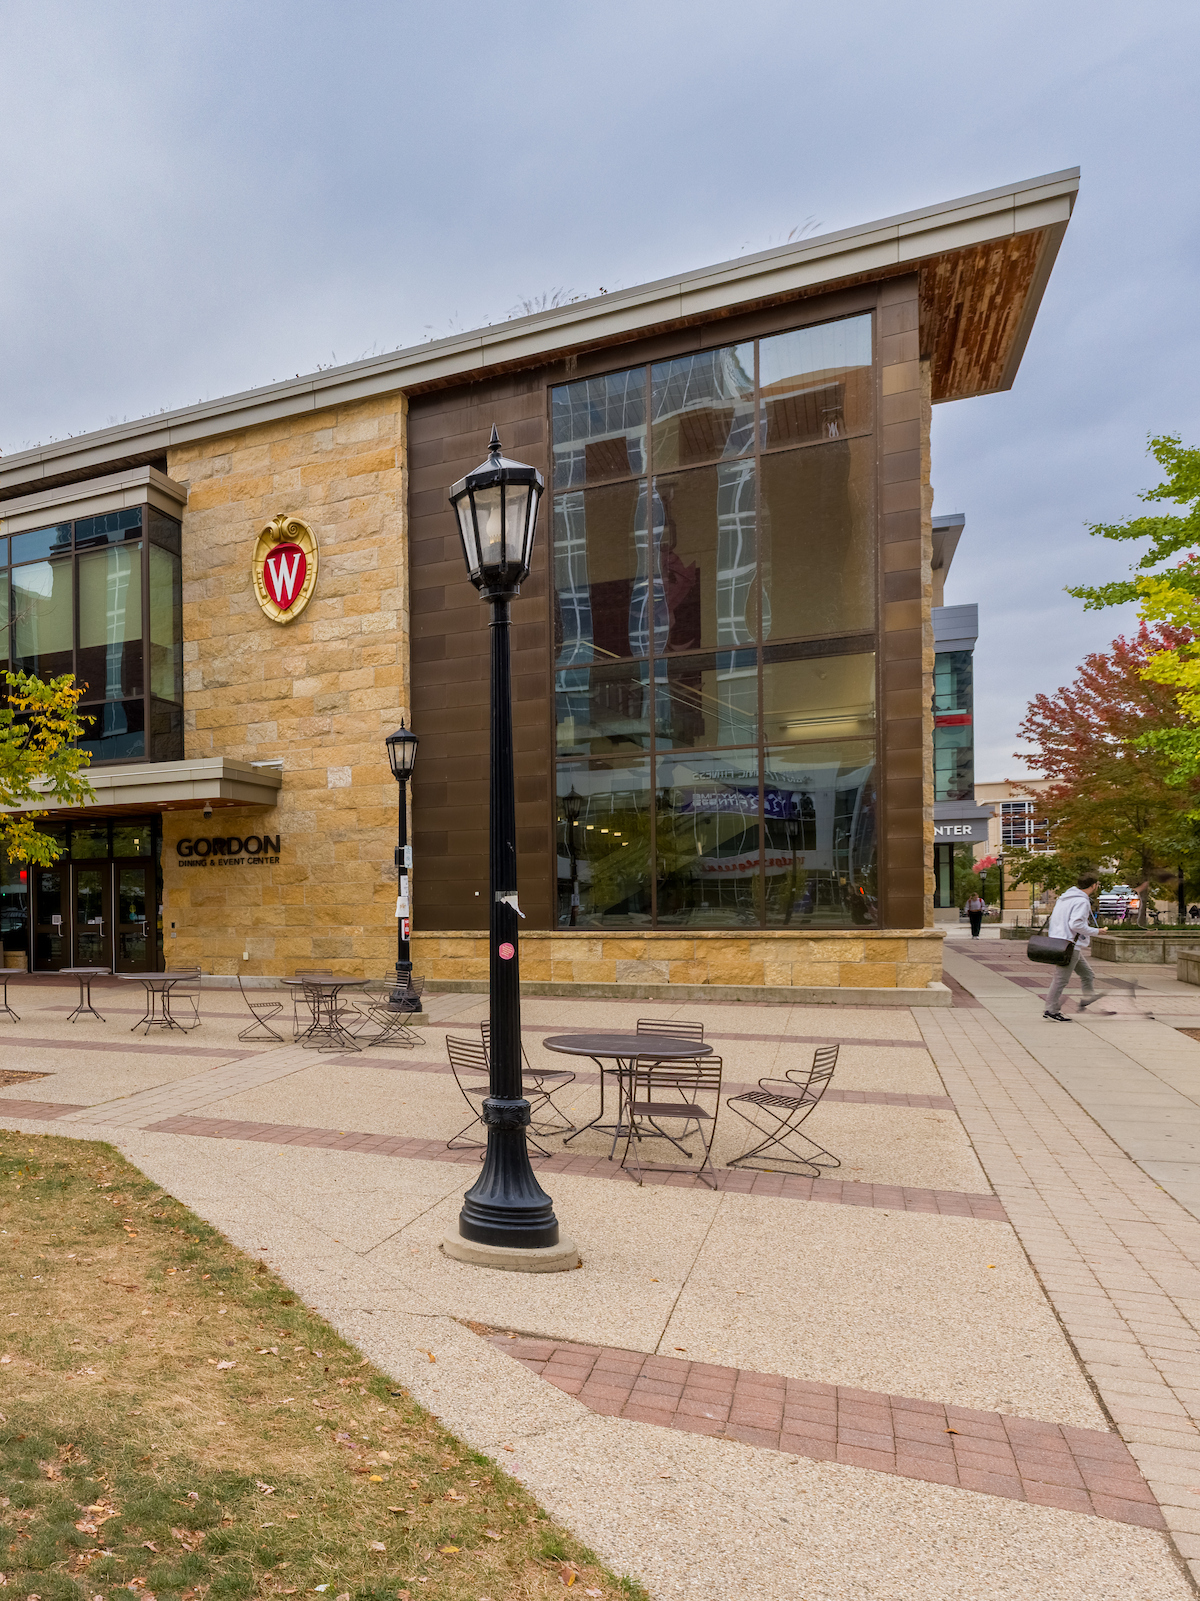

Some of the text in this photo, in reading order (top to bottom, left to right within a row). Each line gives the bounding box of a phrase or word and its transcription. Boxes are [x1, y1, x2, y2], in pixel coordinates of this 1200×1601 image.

[266, 553, 302, 602] W
[176, 834, 281, 857] GORDON
[209, 859, 215, 867] &
[218, 857, 245, 866] EVENT
[247, 856, 280, 865] CENTER
